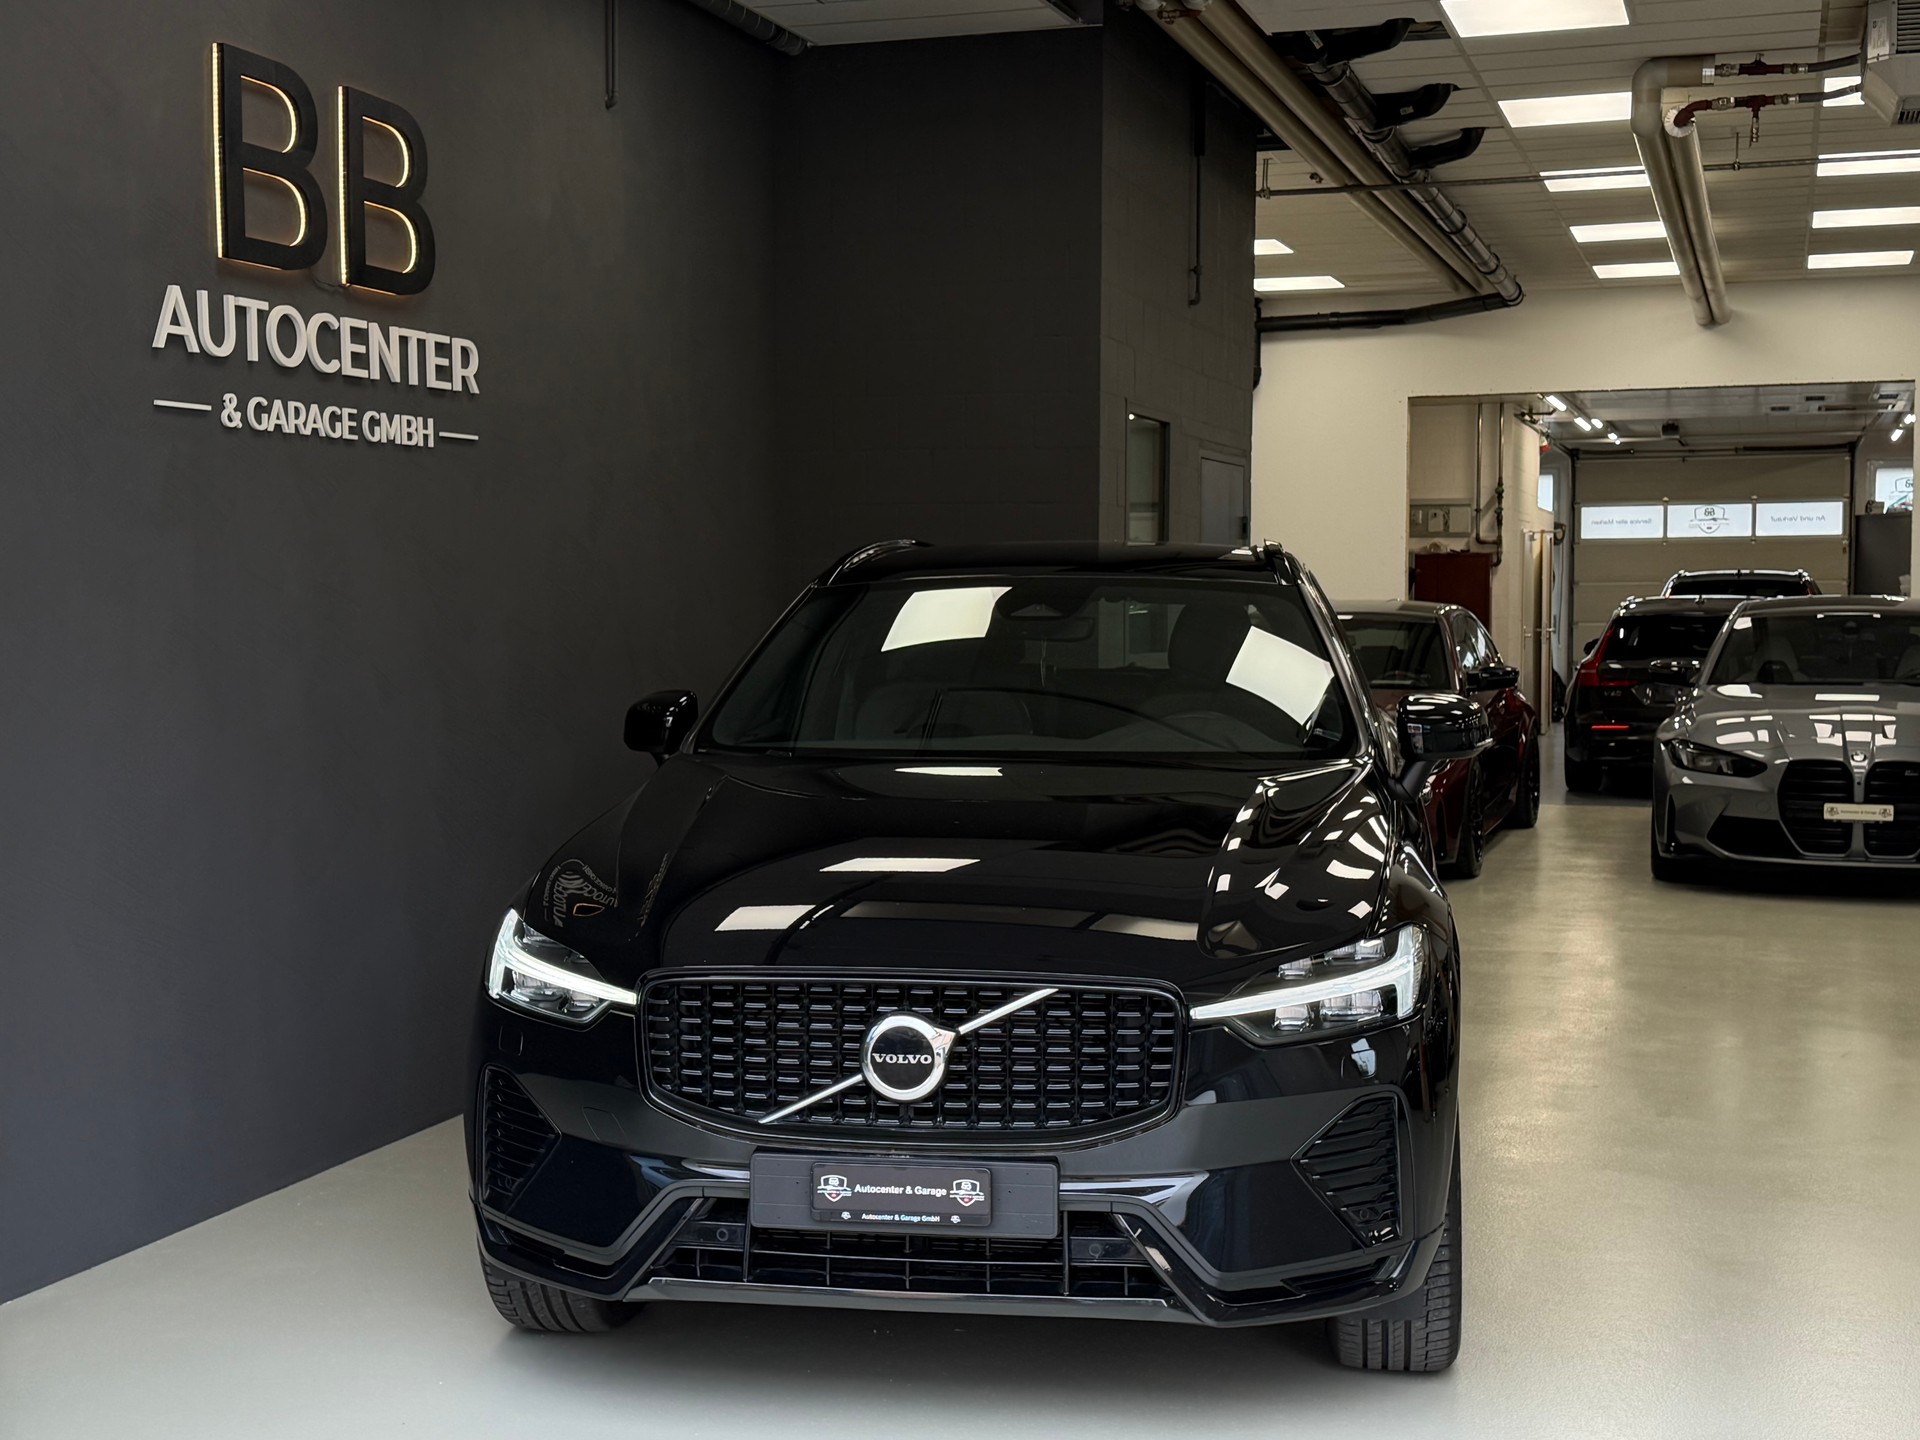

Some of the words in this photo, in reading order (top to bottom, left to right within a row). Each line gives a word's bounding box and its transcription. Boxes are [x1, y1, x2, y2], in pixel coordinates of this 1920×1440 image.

[211, 42, 437, 296] BB
[152, 284, 480, 394] AUTOCENTER
[220, 392, 242, 429] &
[247, 396, 358, 441] GARAGE
[362, 410, 435, 448] GMBH
[872, 1053, 932, 1064] VOLVO
[854, 1184, 904, 1194] Autocenter
[905, 1185, 913, 1194] &
[914, 1186, 947, 1197] Garage
[900, 1214, 921, 1222] Garage
